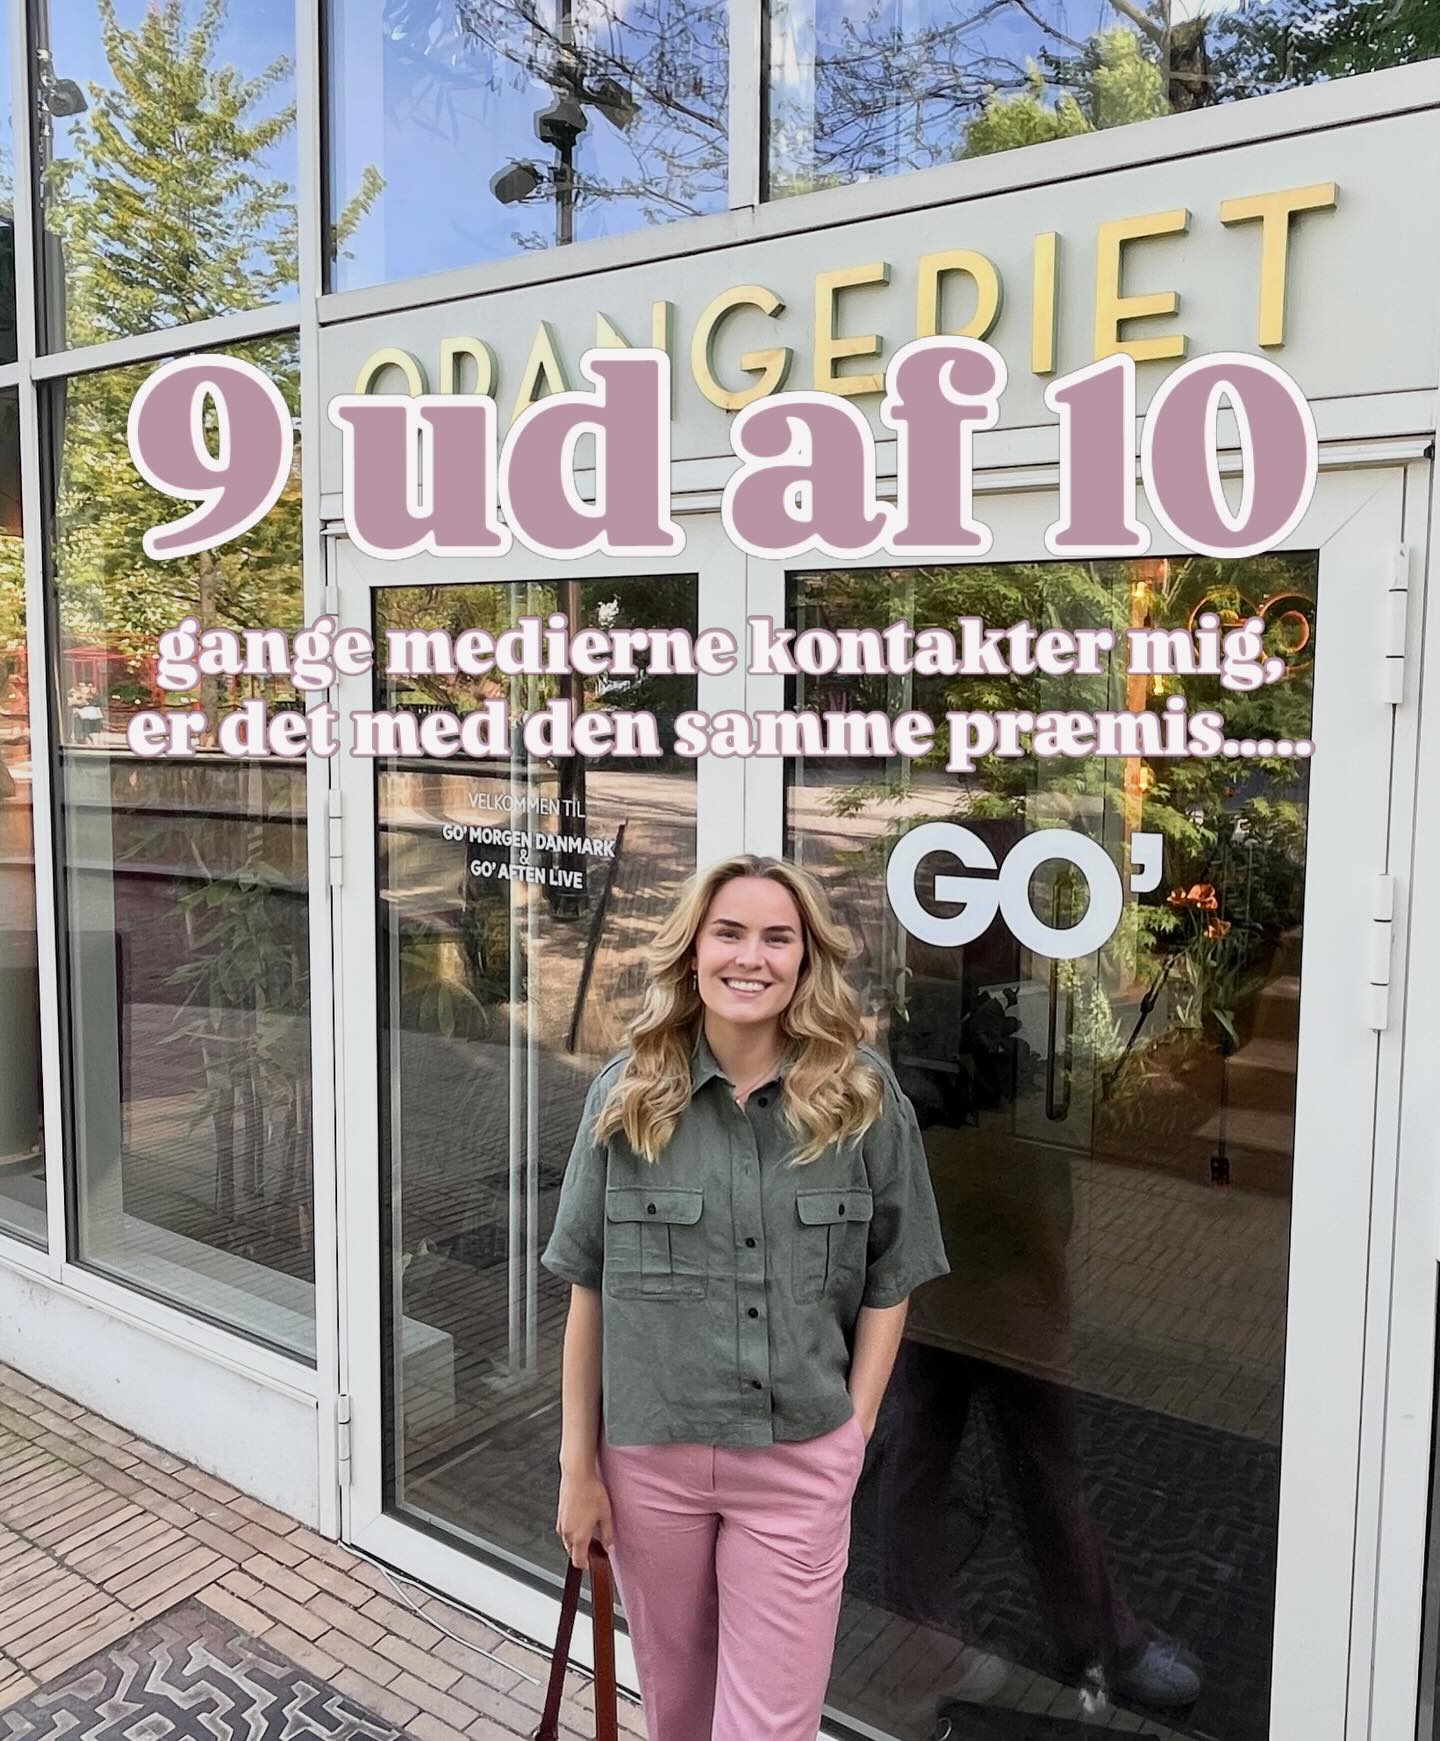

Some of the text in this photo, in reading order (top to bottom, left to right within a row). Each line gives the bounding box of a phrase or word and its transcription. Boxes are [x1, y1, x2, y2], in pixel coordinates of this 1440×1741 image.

[468, 792, 586, 818] VELKOMMEN TIL
[469, 827, 532, 849] MORGEN
[536, 832, 617, 858] DANMARK
[519, 848, 530, 865] &
[498, 863, 546, 884] AFTEN
[549, 868, 584, 889] LIVE
[886, 821, 1164, 959] GO'
